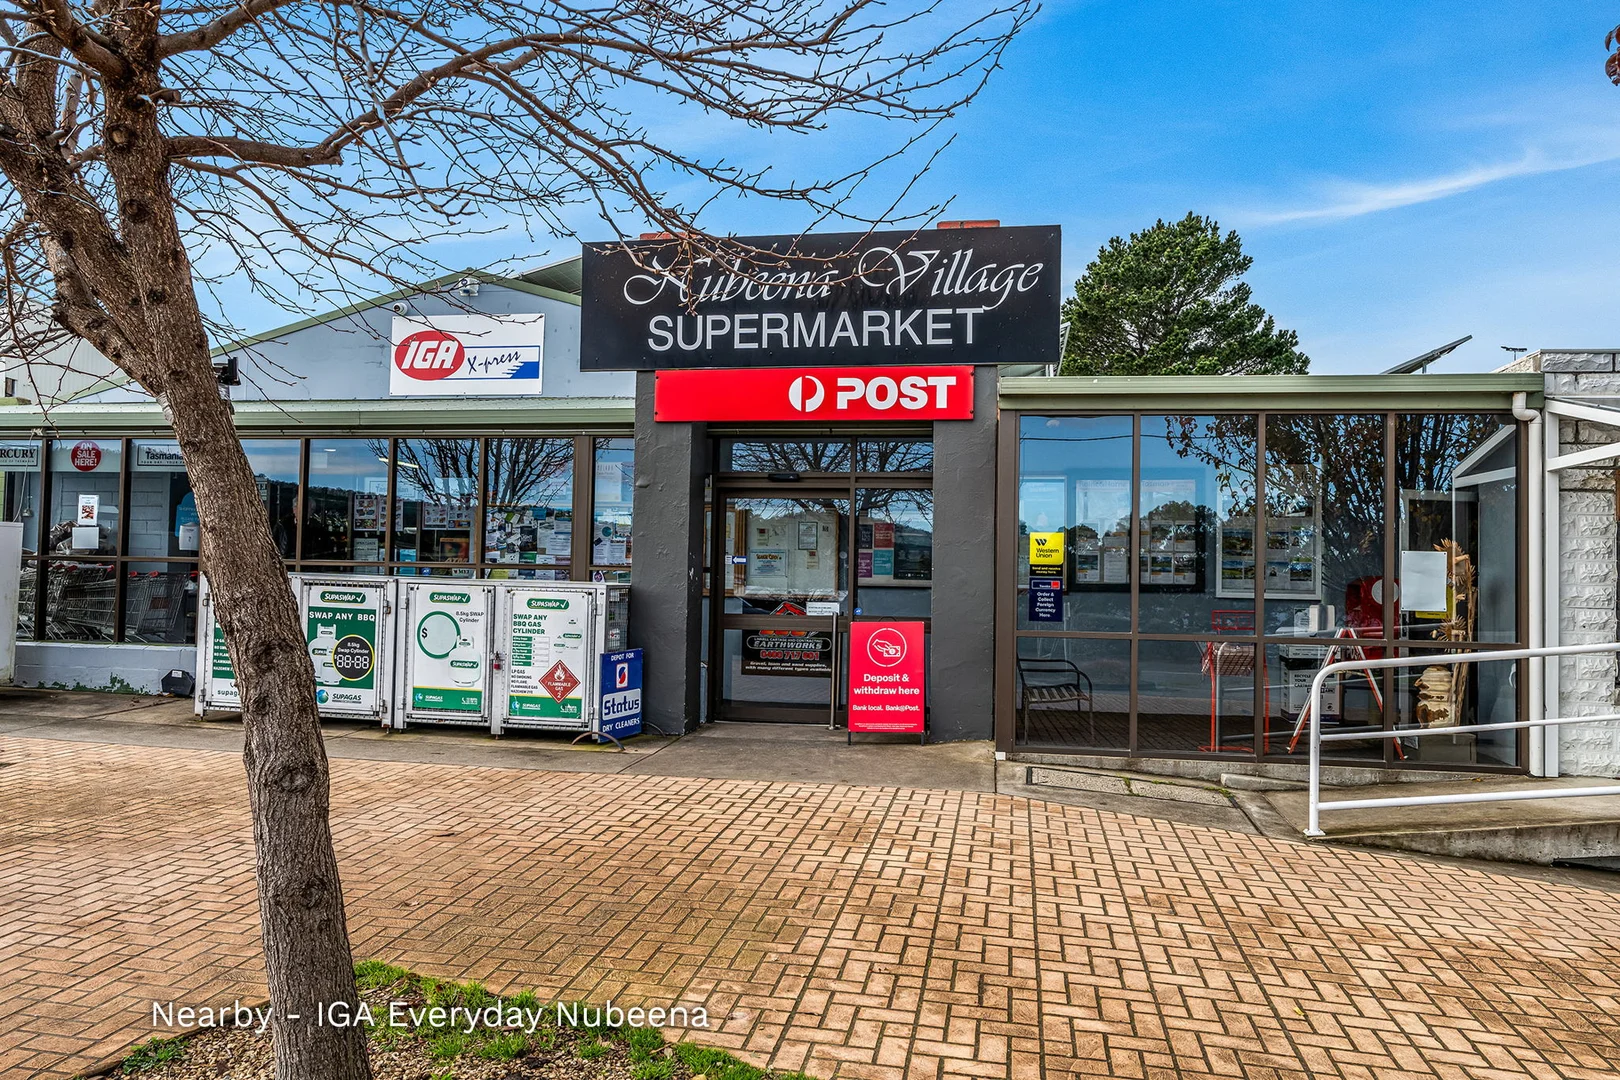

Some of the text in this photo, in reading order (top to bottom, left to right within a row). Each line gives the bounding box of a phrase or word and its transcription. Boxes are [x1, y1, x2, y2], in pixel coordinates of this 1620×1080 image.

[624, 246, 1044, 310] Nubeena Village
[647, 308, 985, 351] SUPERMARKET
[467, 350, 521, 375] X-press
[837, 376, 957, 410] POST
[80, 442, 93, 450] ON
[76, 450, 96, 459] SALE
[145, 451, 185, 460] Tasmania
[74, 458, 97, 467] HERE!
[324, 593, 356, 601] SUPASWAP
[308, 611, 377, 622] SWAP ANY BBQ
[421, 627, 429, 639] $
[753, 641, 823, 649] EARTHWORKS
[784, 651, 801, 660] 717
[863, 673, 910, 684] Deposit &
[556, 691, 562, 699] 2
[853, 686, 920, 695] withdraw here
[332, 693, 361, 701] SUPAGAS
[604, 695, 640, 716] Status
[602, 717, 641, 732] DRY CLEANERS
